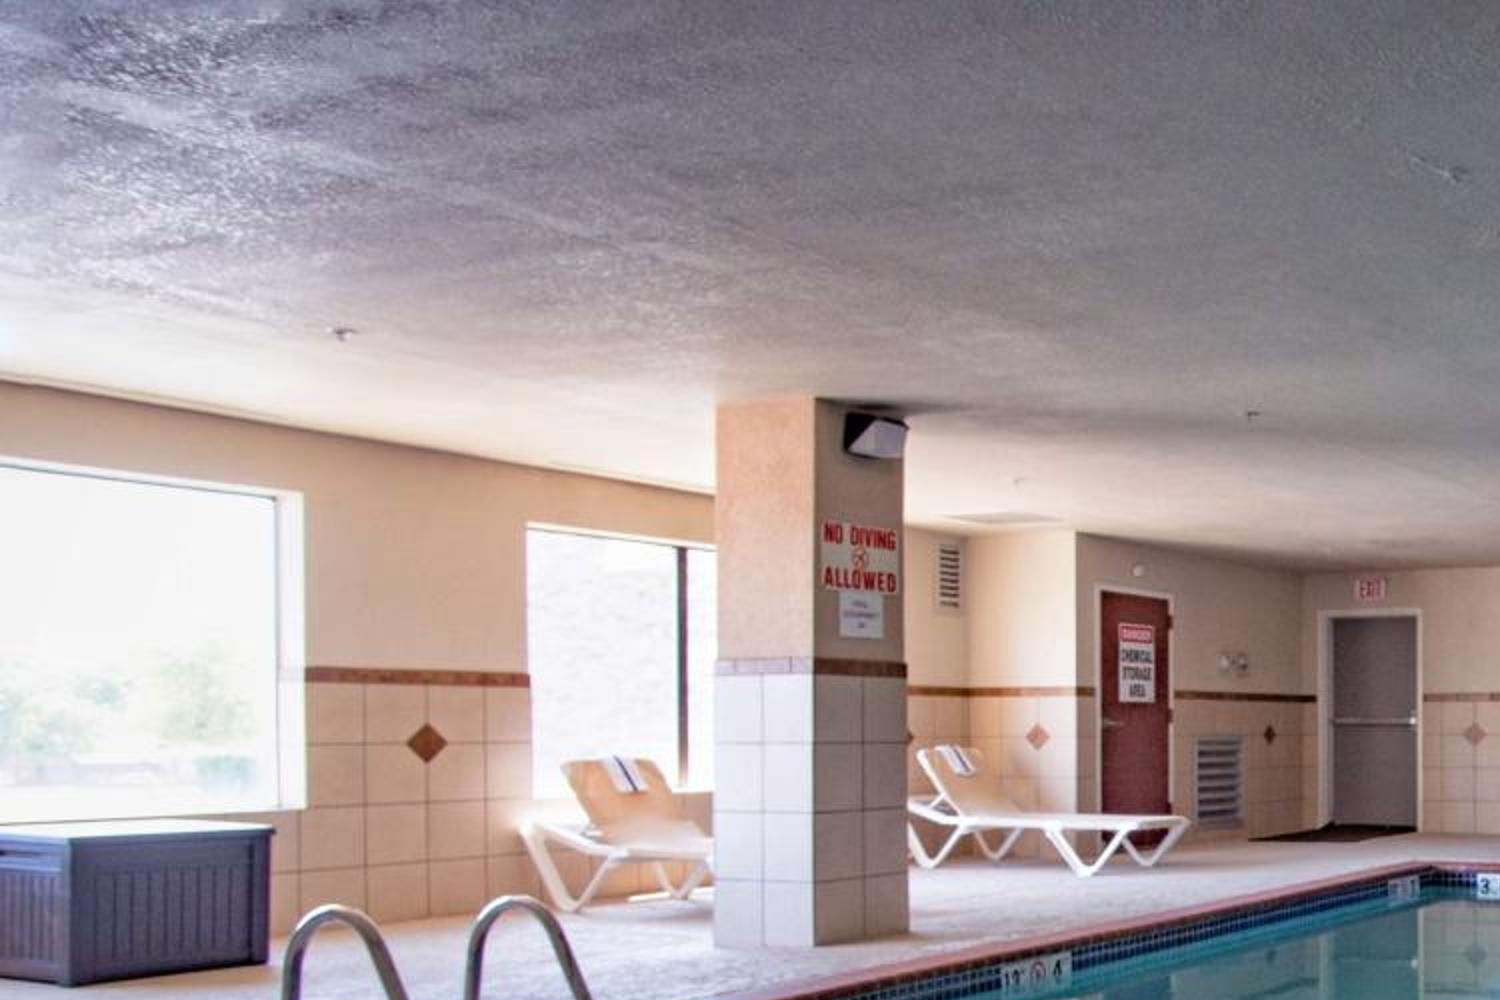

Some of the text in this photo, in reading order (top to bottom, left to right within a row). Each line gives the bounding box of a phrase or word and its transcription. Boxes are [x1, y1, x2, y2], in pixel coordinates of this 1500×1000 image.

[823, 522, 897, 551] NO DIVING
[823, 566, 897, 593] ALLOWED
[1479, 878, 1490, 897] 3
